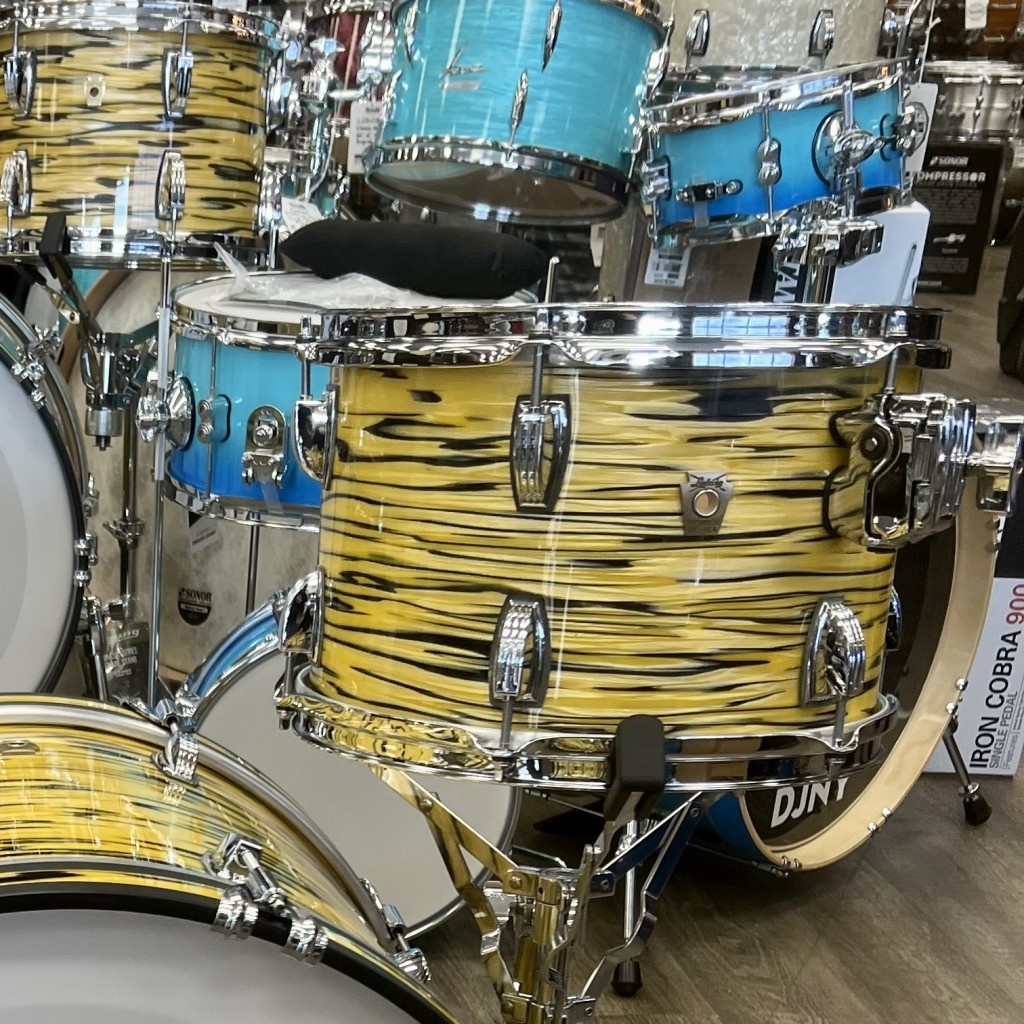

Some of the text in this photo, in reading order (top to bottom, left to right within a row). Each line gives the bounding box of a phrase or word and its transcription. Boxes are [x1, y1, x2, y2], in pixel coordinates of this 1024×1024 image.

[969, 584, 1024, 768] IRON COBRA 900
[989, 729, 1008, 769] SINGLE
[1000, 691, 1018, 727] PEDAL
